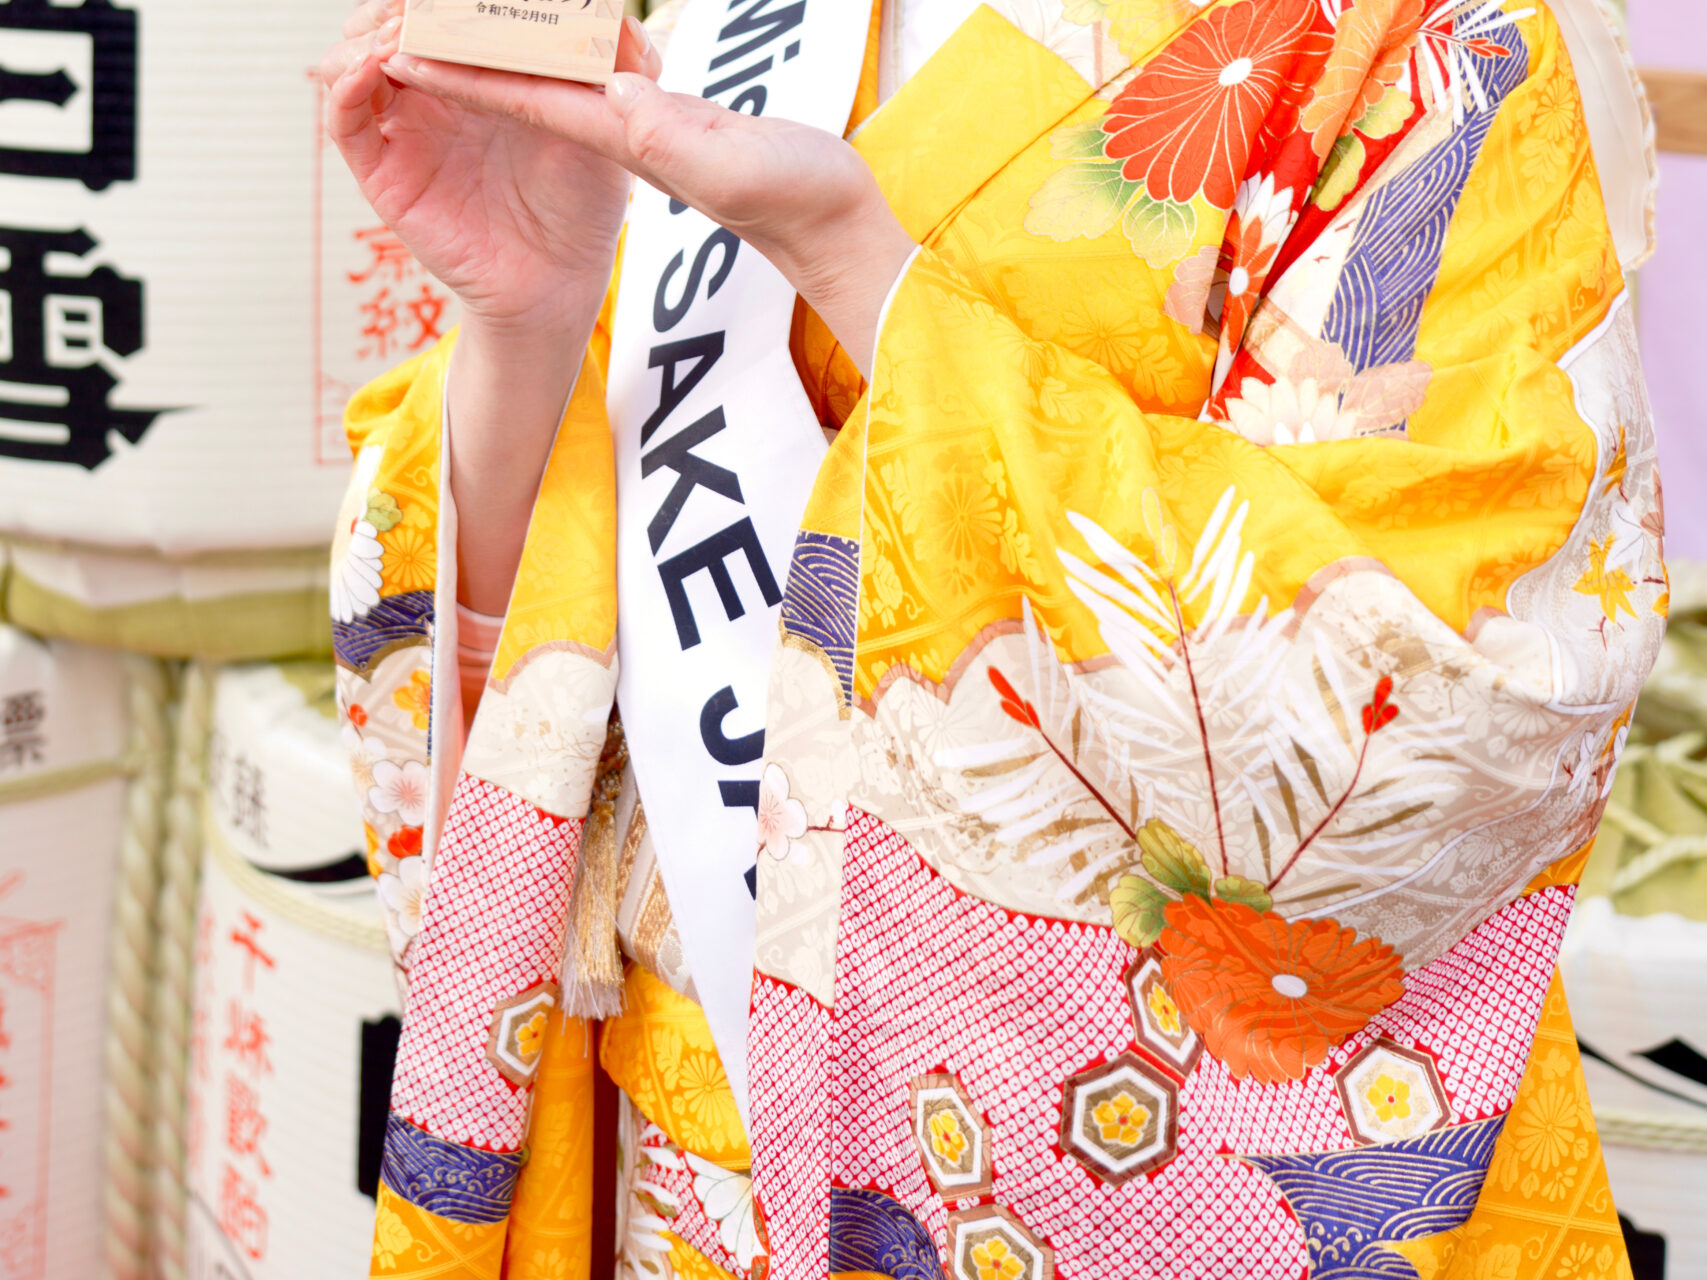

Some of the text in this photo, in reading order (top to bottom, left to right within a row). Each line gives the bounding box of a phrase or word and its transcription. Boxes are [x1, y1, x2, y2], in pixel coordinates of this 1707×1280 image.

[475, 1, 559, 25] 令和7年2月9日
[641, 225, 784, 651] SAKE
